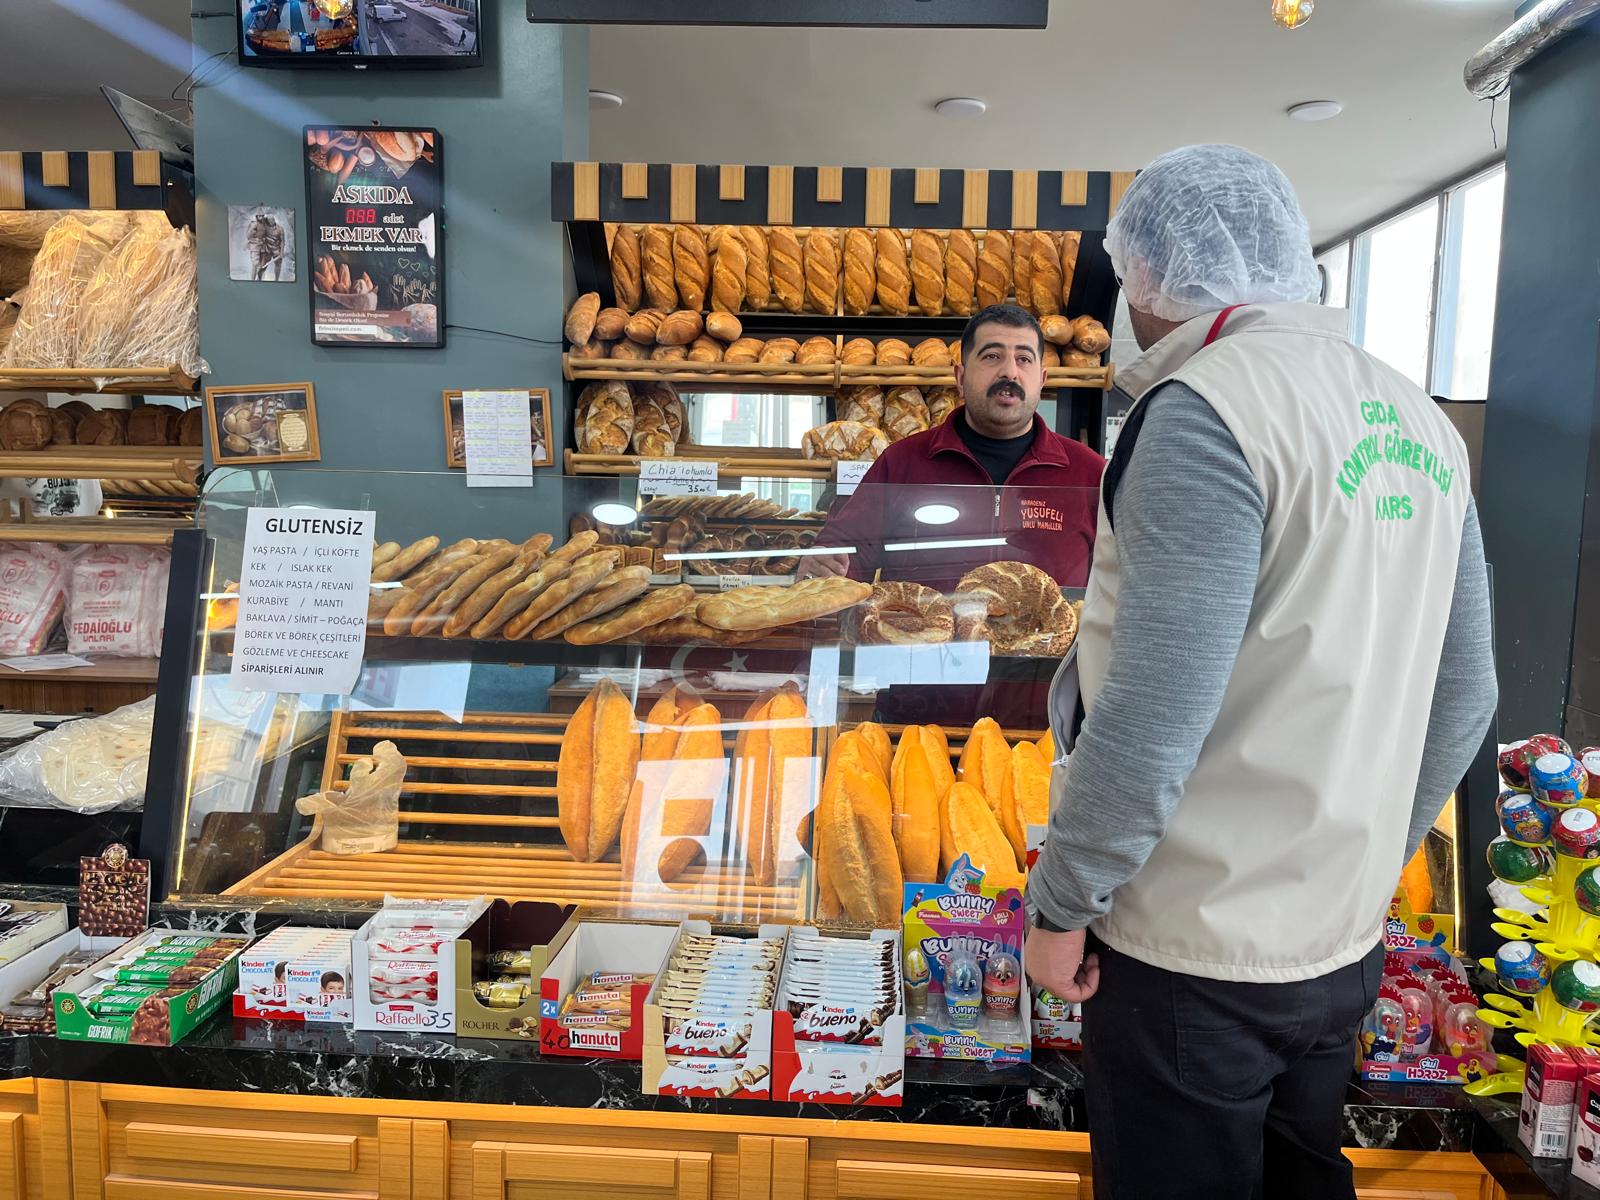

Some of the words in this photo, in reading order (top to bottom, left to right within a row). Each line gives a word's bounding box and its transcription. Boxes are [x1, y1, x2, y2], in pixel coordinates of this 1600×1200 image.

[332, 184, 413, 204] ASKIDA
[383, 213, 405, 224] adet
[320, 226, 385, 243] EKMEK
[385, 227, 425, 243] VAR
[1361, 401, 1401, 429] GIDA
[1375, 495, 1413, 520] KARS
[265, 517, 363, 536] GLUTENSİZ
[252, 546, 268, 555] YAŞ
[270, 546, 297, 555] PASTA
[302, 546, 308, 557] /
[250, 562, 266, 571] KEK
[277, 563, 282, 572] /
[291, 563, 314, 573] ISLAK
[316, 564, 333, 573] KEK
[286, 580, 313, 589] PASTA
[314, 581, 319, 591] /
[247, 596, 289, 606] KURABİYE
[300, 597, 306, 607] /
[314, 598, 343, 608] MANTI
[73, 618, 132, 634] FEDAİOĞLU
[246, 613, 285, 622] BAKLAVA
[287, 614, 293, 624] /
[328, 615, 364, 626] POĞAÇA
[275, 631, 286, 640] VE
[287, 649, 298, 658] VE
[300, 649, 349, 659] CHEESCAKE
[241, 662, 293, 675] SİPARİŞLERİ
[295, 665, 324, 675] ALINIR
[593, 975, 631, 984] hanuta
[580, 992, 619, 1001] hanuta
[376, 1011, 430, 1026] Raffaello
[424, 1009, 453, 1029] 35
[565, 1016, 605, 1024] hanuta
[809, 1013, 857, 1027] bueno
[87, 1025, 114, 1039] GOFRIK
[462, 1020, 500, 1031] ROCHER
[571, 1030, 619, 1046] hanuta
[684, 1026, 727, 1039] bueno
[1408, 1067, 1446, 1080] HOROZ
